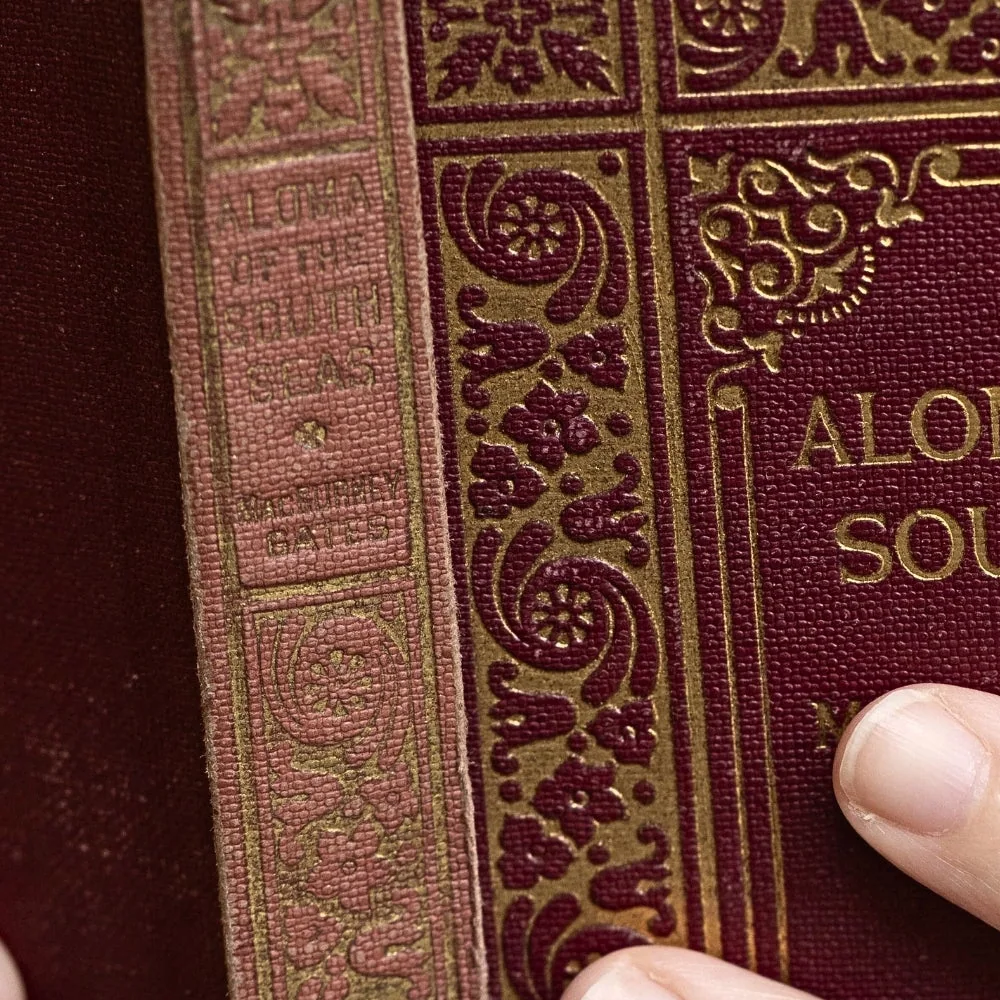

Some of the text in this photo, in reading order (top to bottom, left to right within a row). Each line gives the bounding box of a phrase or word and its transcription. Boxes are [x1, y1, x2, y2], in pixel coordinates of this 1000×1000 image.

[216, 173, 371, 234] ALOMA
[222, 284, 382, 350] SOUTH
[246, 347, 376, 404] SEAS
[266, 512, 390, 558] GATES
